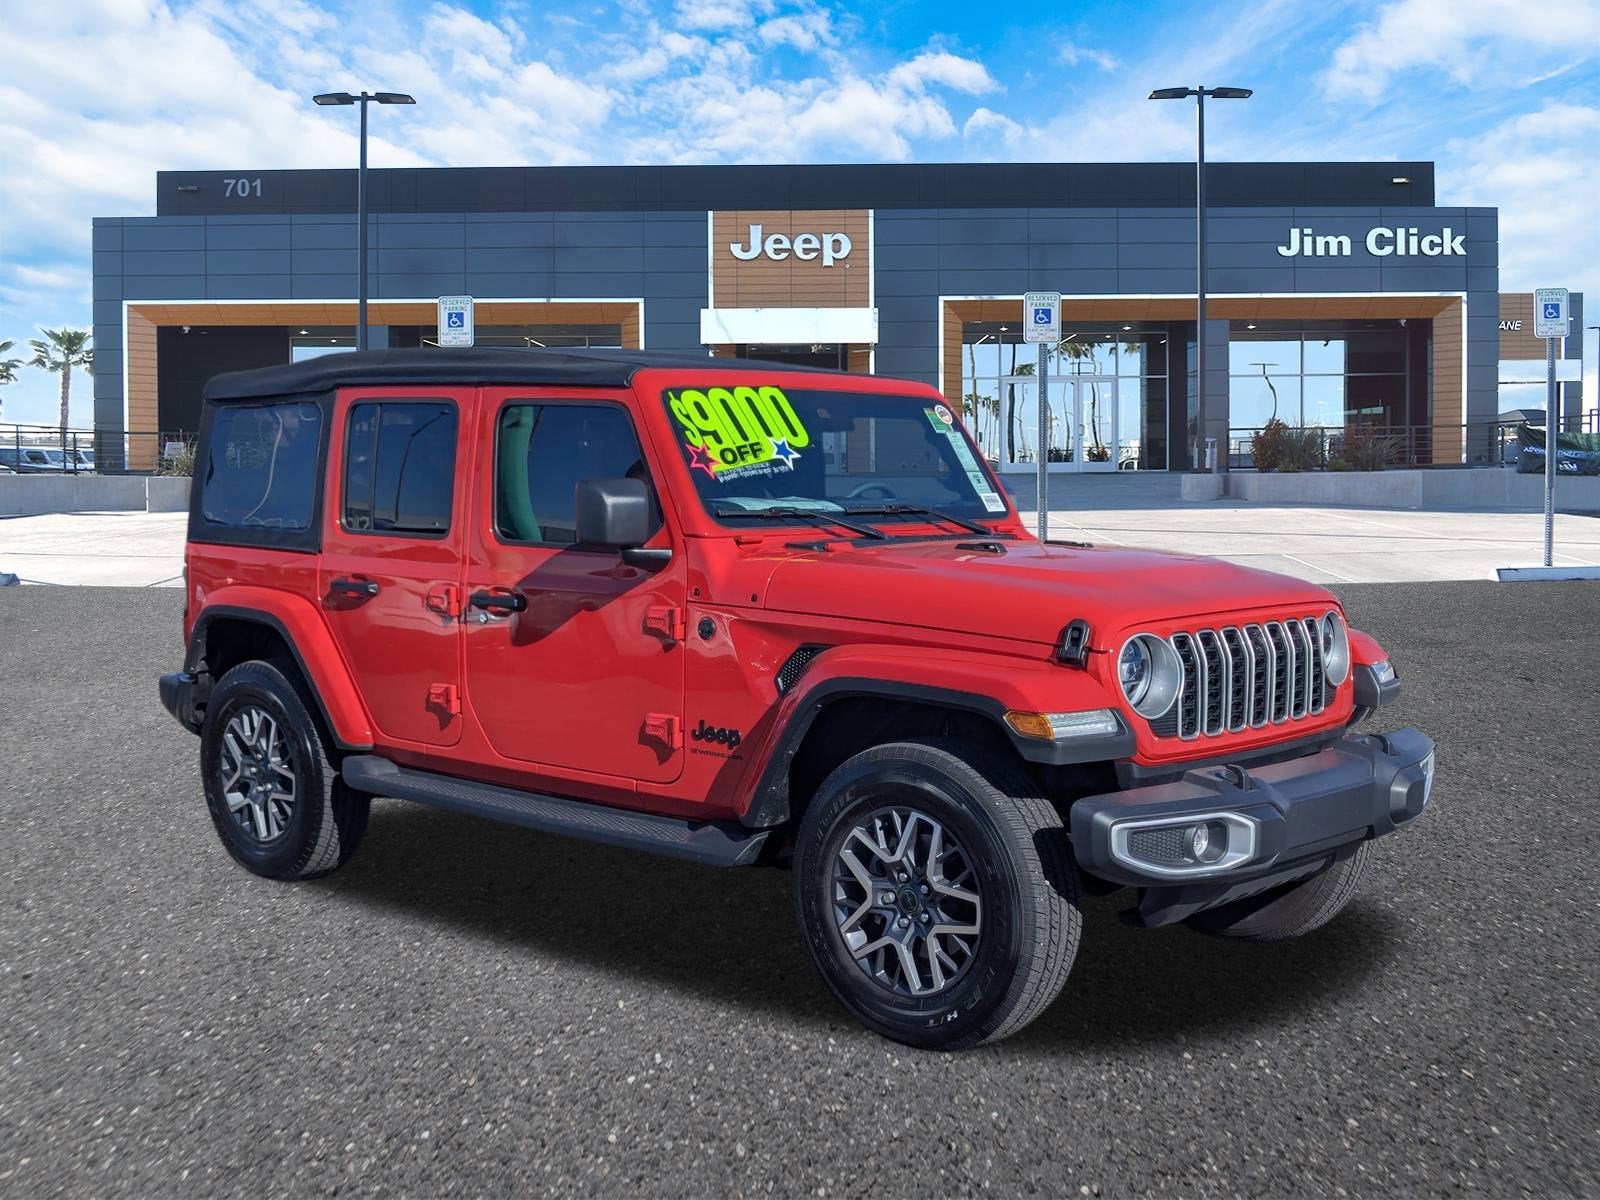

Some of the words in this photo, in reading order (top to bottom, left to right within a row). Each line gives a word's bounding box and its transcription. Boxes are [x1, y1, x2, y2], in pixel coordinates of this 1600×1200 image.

[223, 178, 261, 197] 701
[730, 224, 852, 267] Jeep
[1277, 227, 1351, 257] Jim
[1366, 227, 1467, 256] Click
[668, 386, 809, 448] $9000
[719, 441, 765, 466] OFF
[691, 719, 741, 750] Jeep
